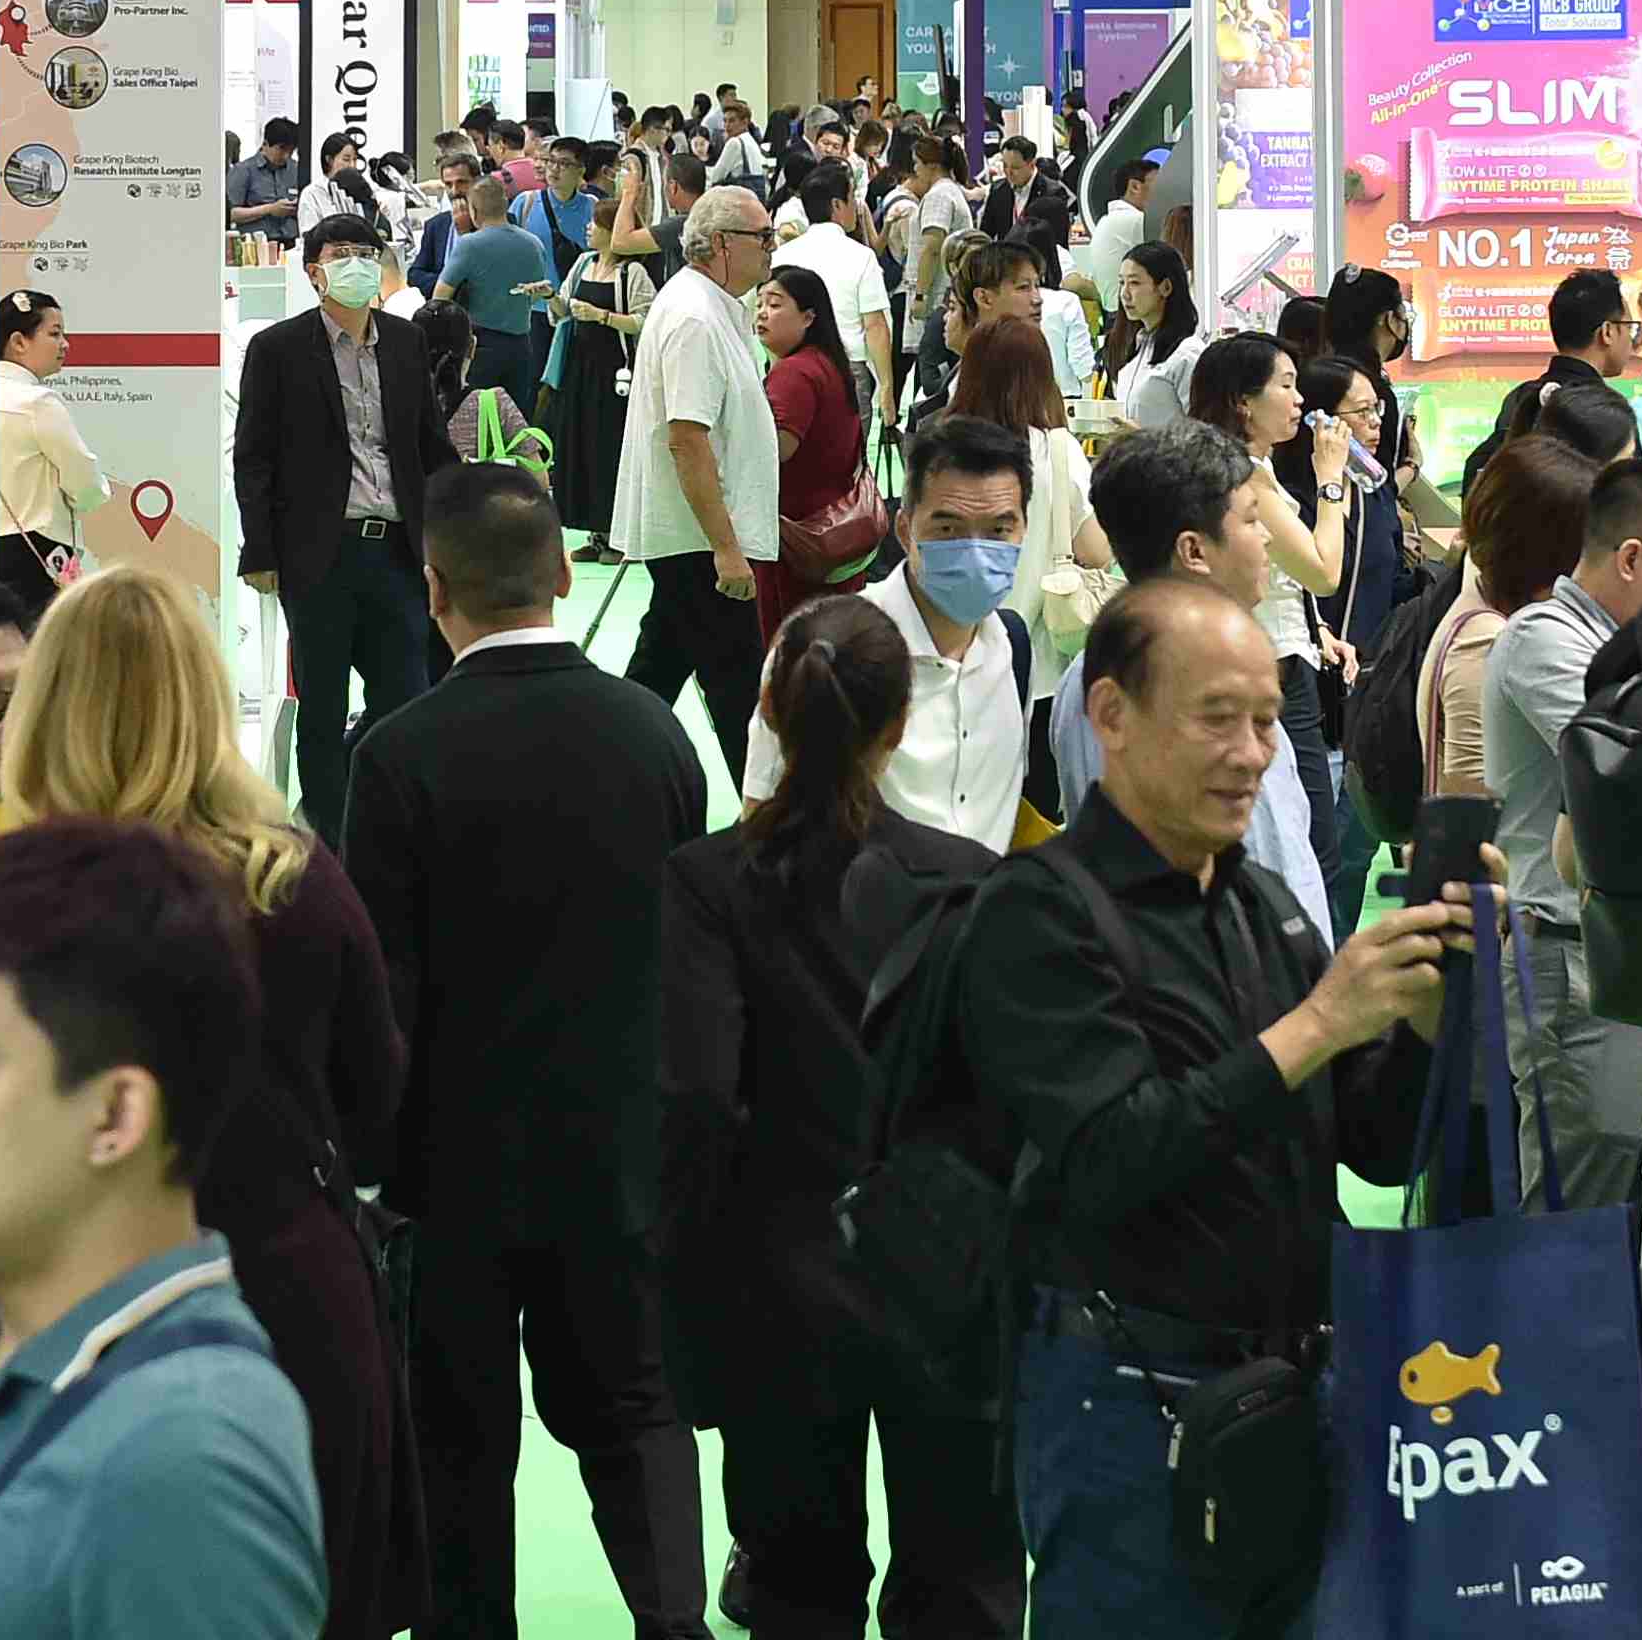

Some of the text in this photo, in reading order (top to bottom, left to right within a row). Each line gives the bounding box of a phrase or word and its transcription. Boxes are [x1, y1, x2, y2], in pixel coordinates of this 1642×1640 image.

[113, 6, 189, 16] Pro-Partner Inc.
[112, 67, 179, 79] Grape King Bio
[1367, 50, 1473, 108] Beauty Collection
[112, 78, 198, 90] Sales Office Taipei
[1447, 78, 1620, 127] SLIM
[73, 154, 159, 167] Grape King Biotech
[1260, 153, 1307, 168] EXTRACT
[73, 166, 202, 178] Research Institute Longtan
[1487, 165, 1516, 177] LITE
[1509, 179, 1579, 193] PROTEIN
[27, 240, 48, 252] King
[49, 240, 65, 249] Bio
[65, 239, 88, 249] Park
[1438, 226, 1600, 268] NO.1 Japan
[1543, 248, 1597, 266] Korea
[1438, 304, 1517, 318] GLOW LITE
[1438, 319, 1508, 333] ANYTIME
[69, 375, 123, 388] Philippines,
[103, 391, 125, 403] Italy,
[126, 392, 153, 404] Spain
